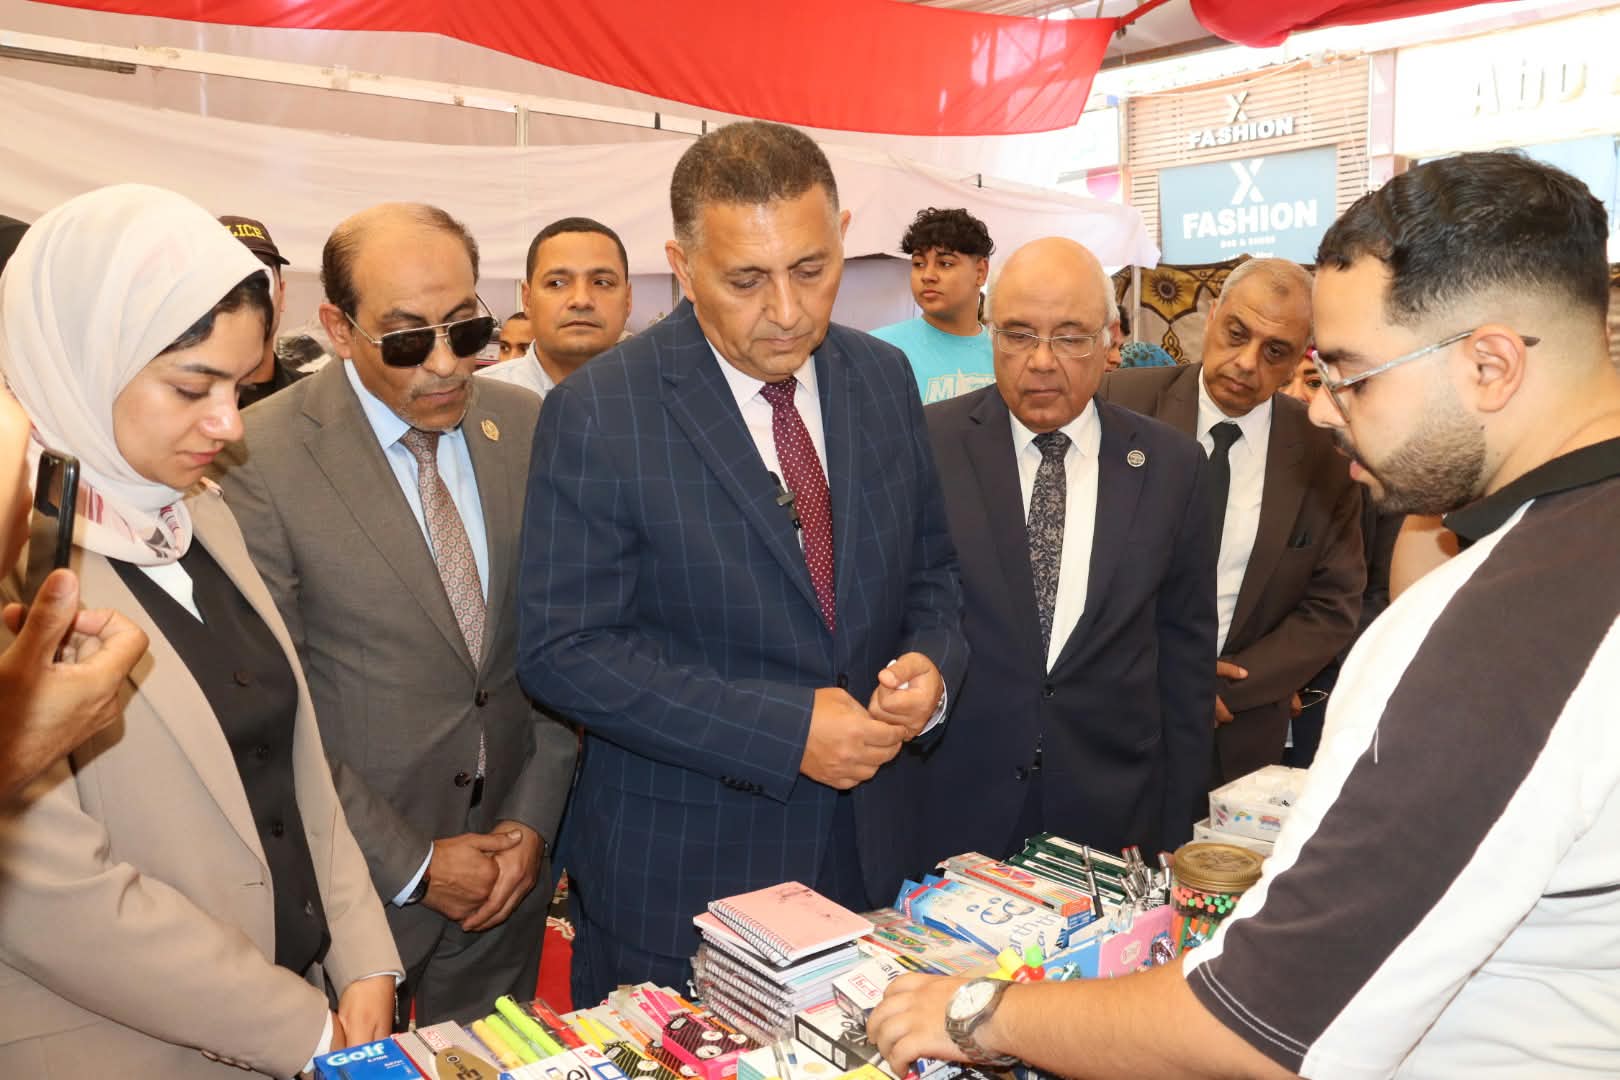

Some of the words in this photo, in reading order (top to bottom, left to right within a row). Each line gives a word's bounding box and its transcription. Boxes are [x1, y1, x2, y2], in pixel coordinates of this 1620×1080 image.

[1226, 90, 1248, 122] X
[1187, 117, 1296, 148] FASHION
[1231, 158, 1265, 205] X
[1183, 200, 1318, 239] FASHION
[326, 1042, 385, 1067] Golf
